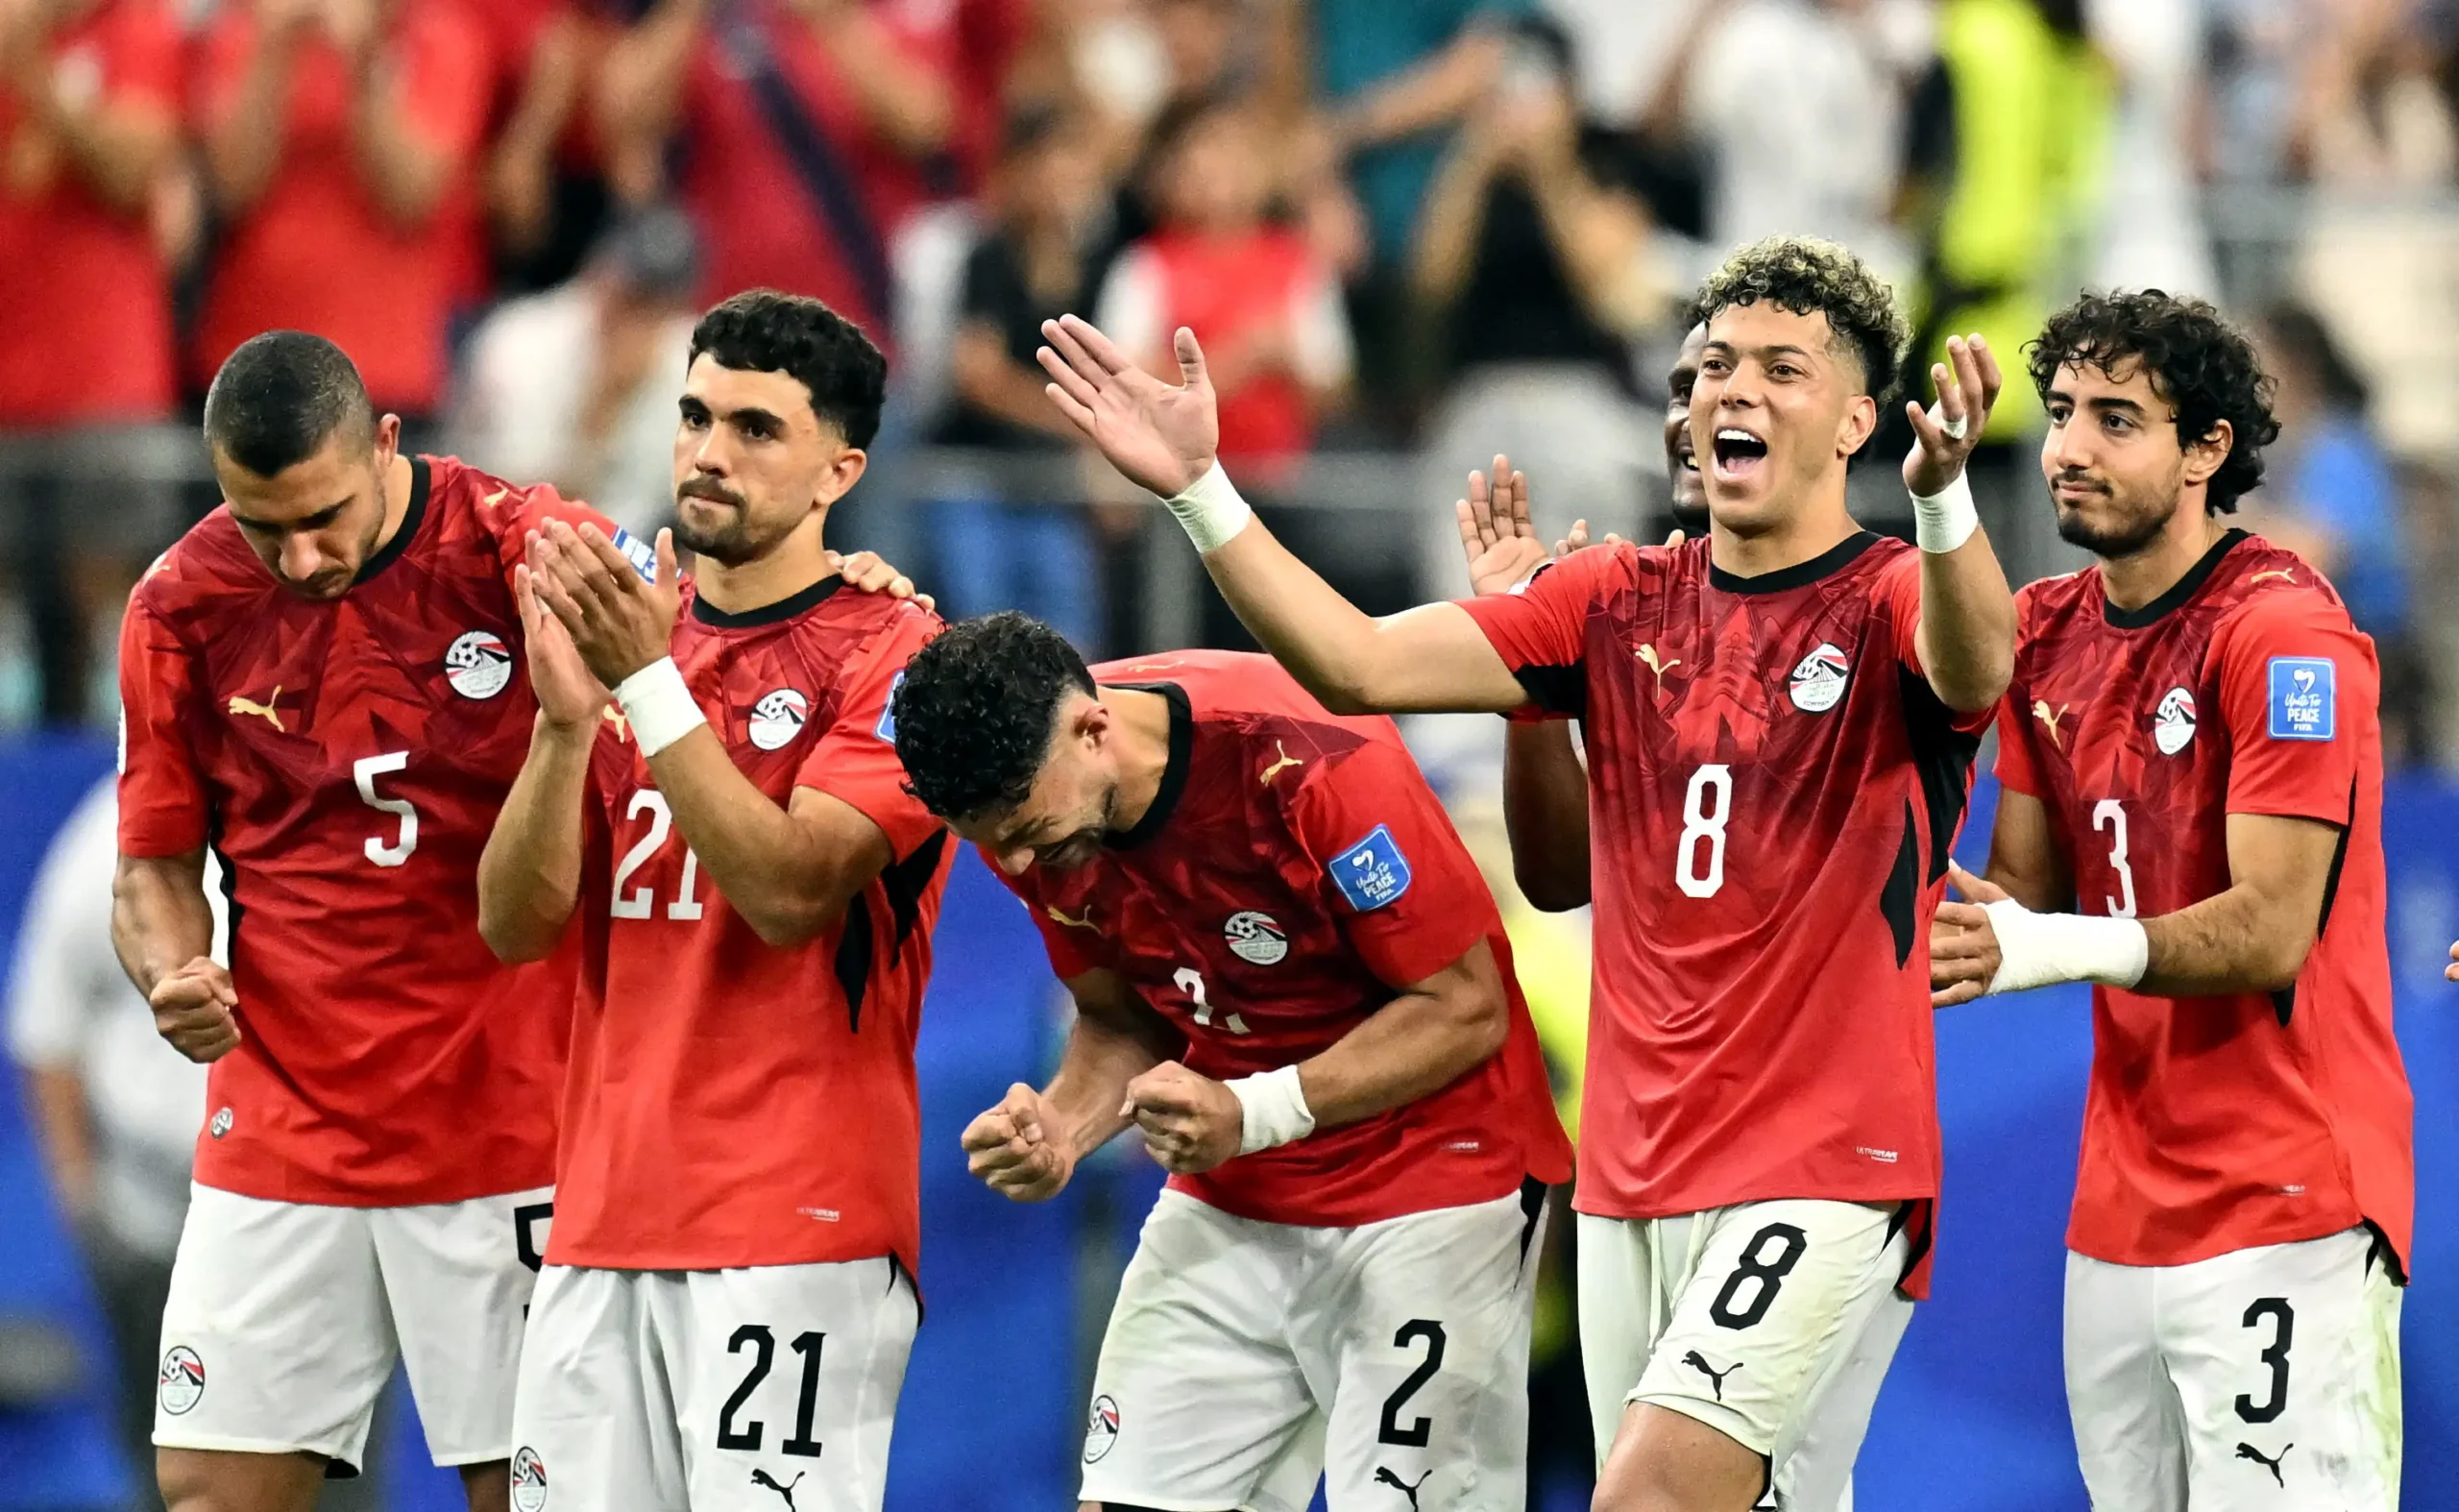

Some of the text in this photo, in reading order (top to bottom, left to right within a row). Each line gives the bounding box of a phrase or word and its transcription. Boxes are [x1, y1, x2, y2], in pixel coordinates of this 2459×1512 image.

[2287, 708, 2320, 722] PEACE
[353, 750, 418, 867] 5
[611, 789, 703, 920] 21
[1675, 764, 1733, 898] 8
[2092, 799, 2137, 919] 3
[1363, 871, 1397, 898] PEACE
[1709, 1222, 1808, 1330] 8
[717, 1324, 826, 1458] 21
[1378, 1319, 1447, 1448] 2
[2234, 1297, 2295, 1424] 3
